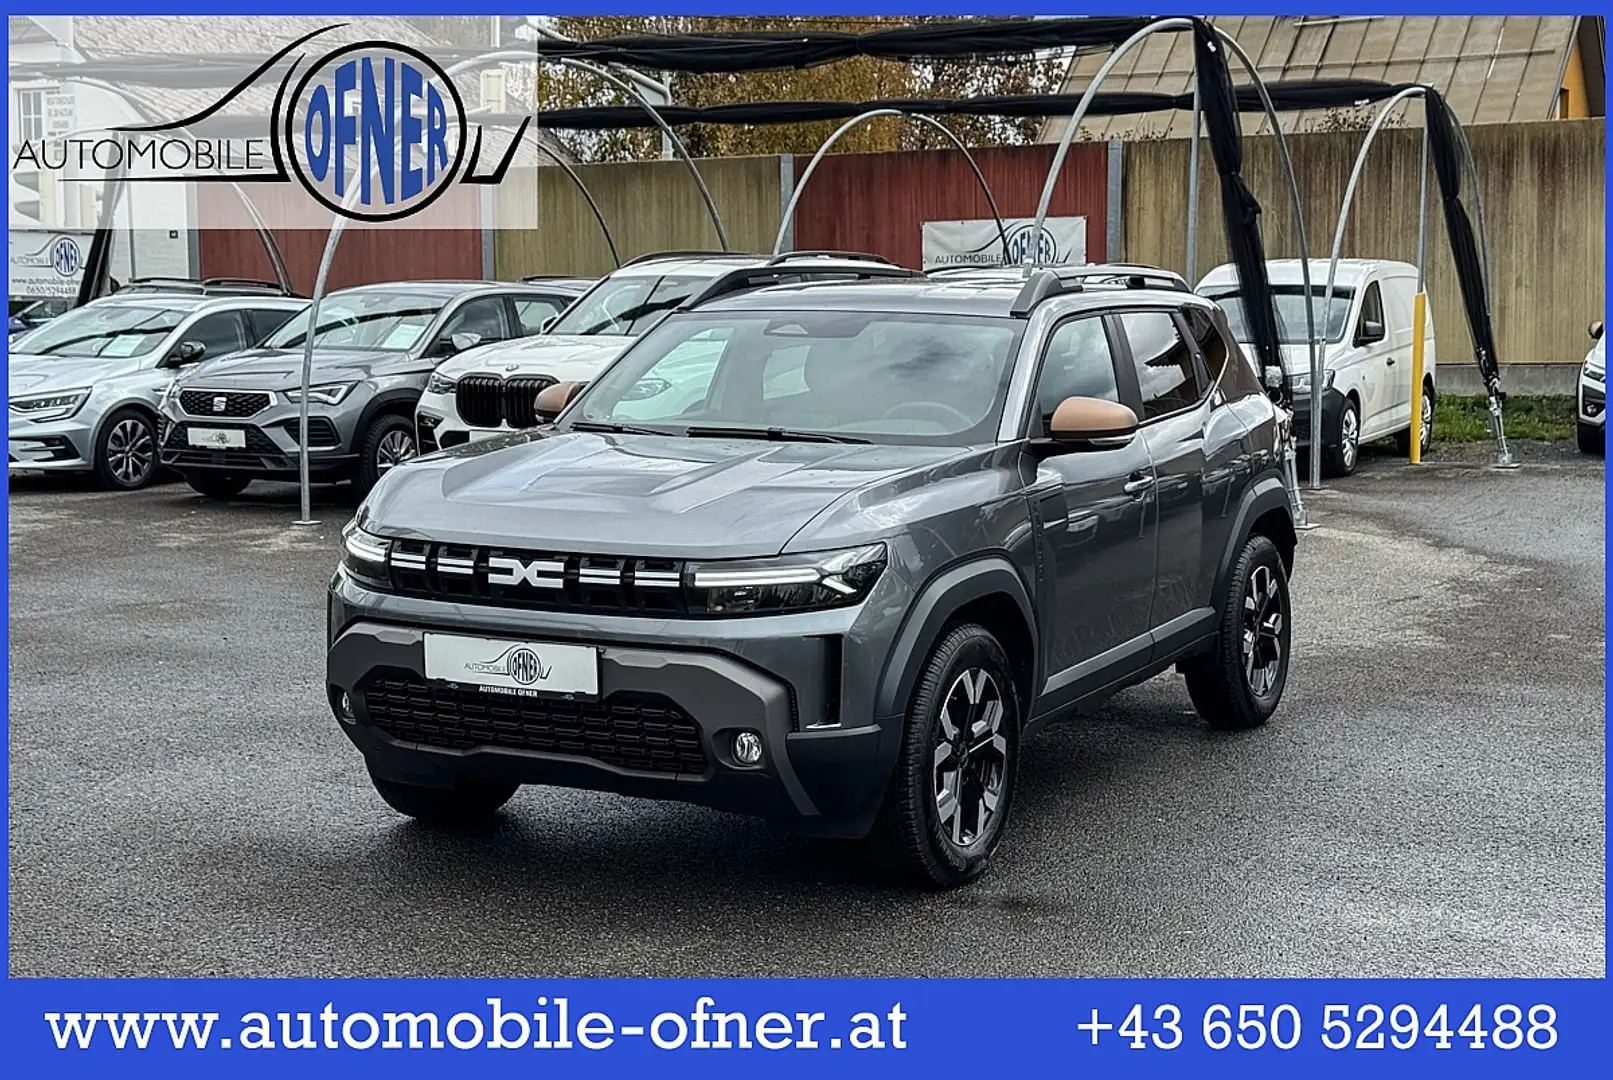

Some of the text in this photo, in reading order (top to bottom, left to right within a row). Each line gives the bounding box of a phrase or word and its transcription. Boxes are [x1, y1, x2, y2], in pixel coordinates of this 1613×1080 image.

[934, 254, 1001, 264] AUTOMOBILE
[463, 651, 538, 682] AUTOMOBILE OFNER
[478, 684, 538, 698] AUTOMOBILE OFNER
